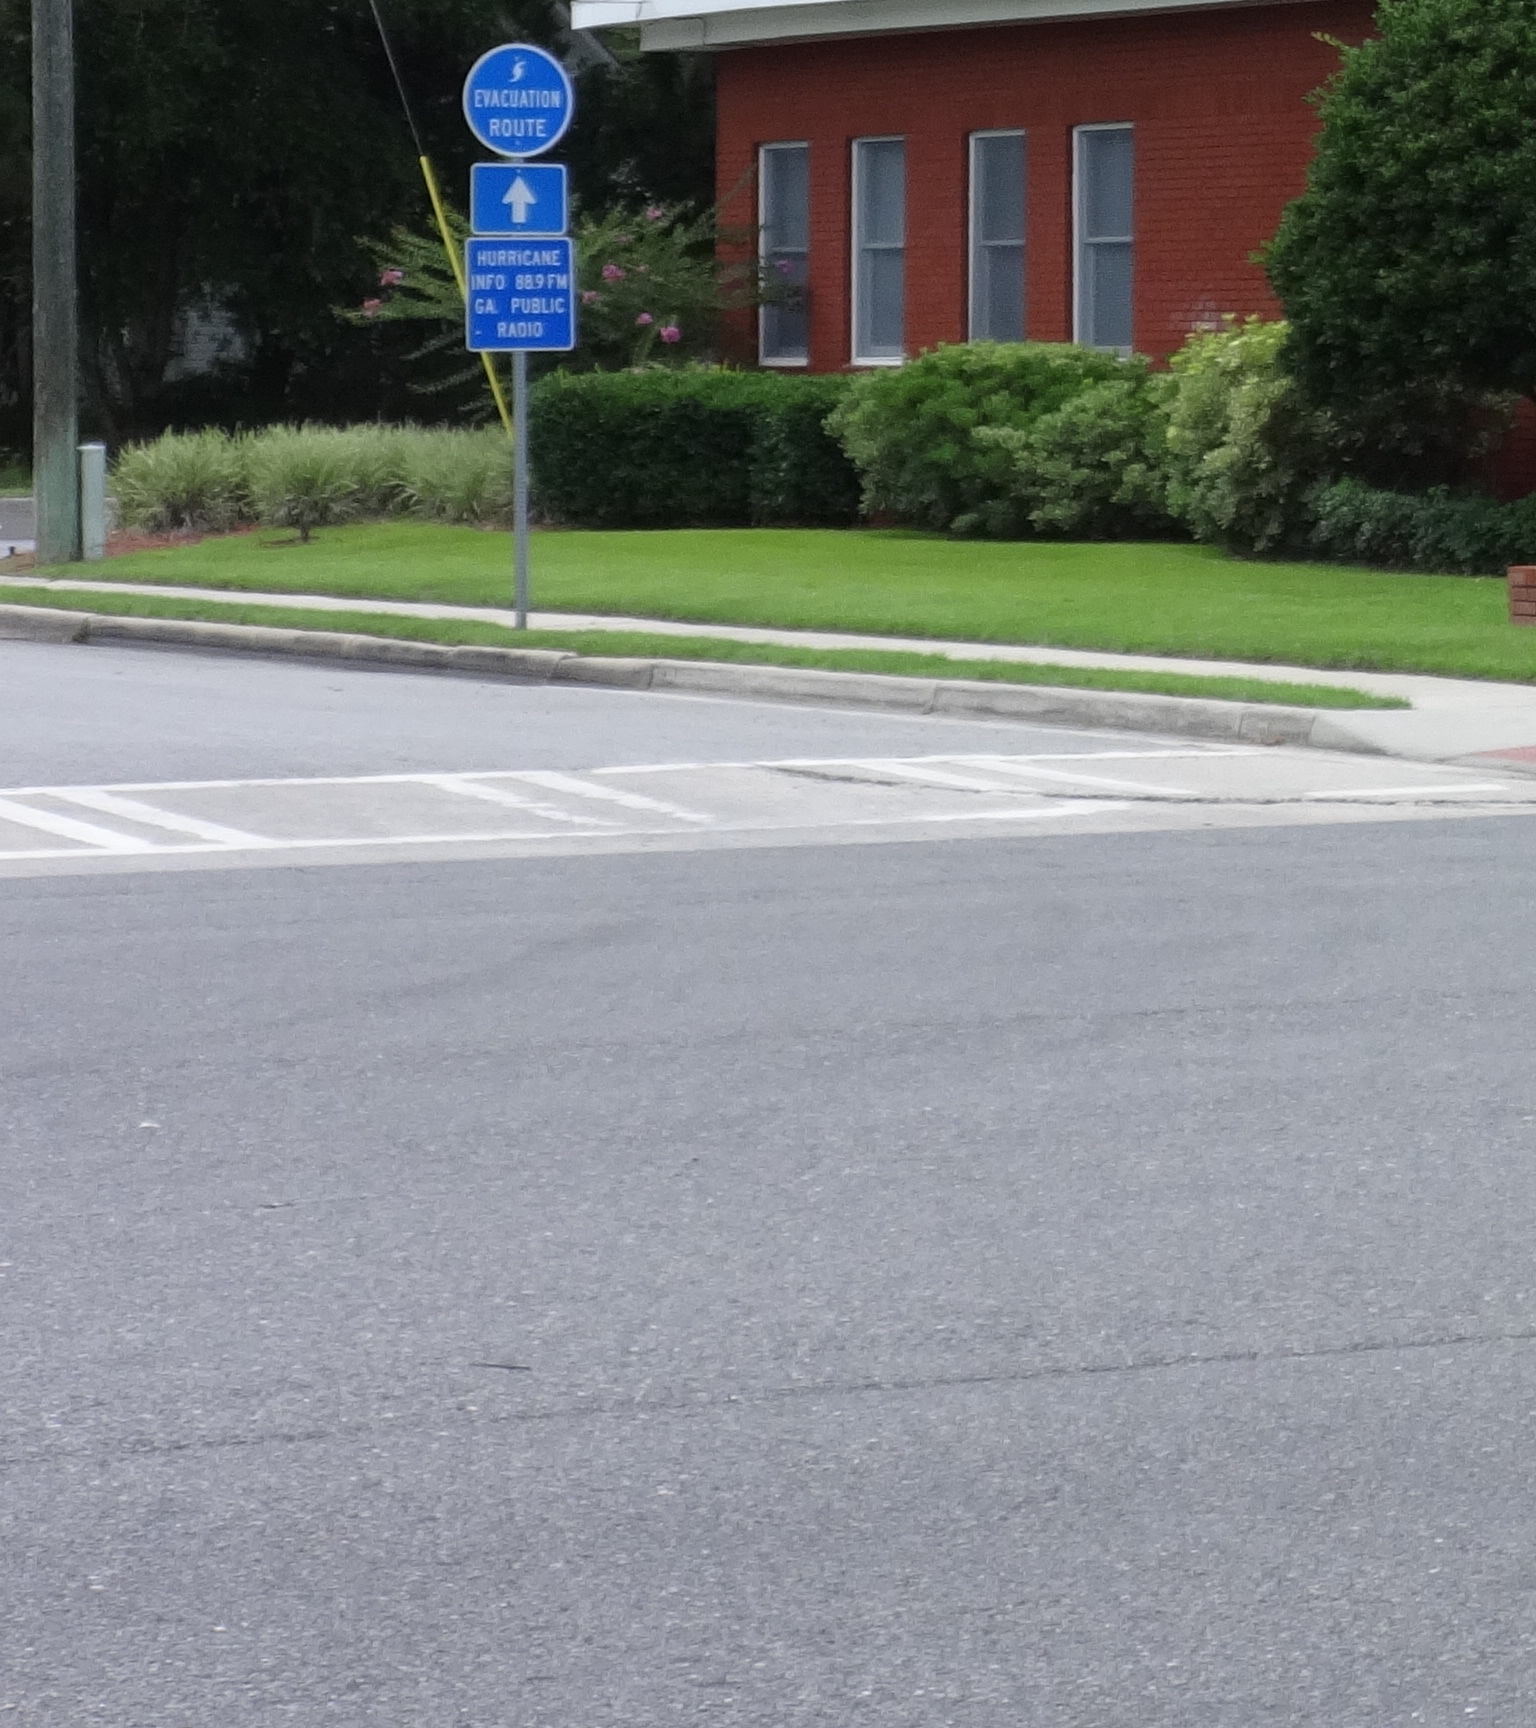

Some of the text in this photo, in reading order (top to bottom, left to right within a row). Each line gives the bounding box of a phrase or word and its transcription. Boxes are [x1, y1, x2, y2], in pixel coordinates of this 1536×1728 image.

[474, 88, 562, 108] EVACUATION
[489, 118, 547, 137] ROUTE
[477, 249, 561, 267] HURRICANE
[470, 274, 505, 290] INFO
[547, 274, 568, 290] FM
[510, 297, 566, 314] PUBLIC
[496, 321, 544, 338] RADIO
